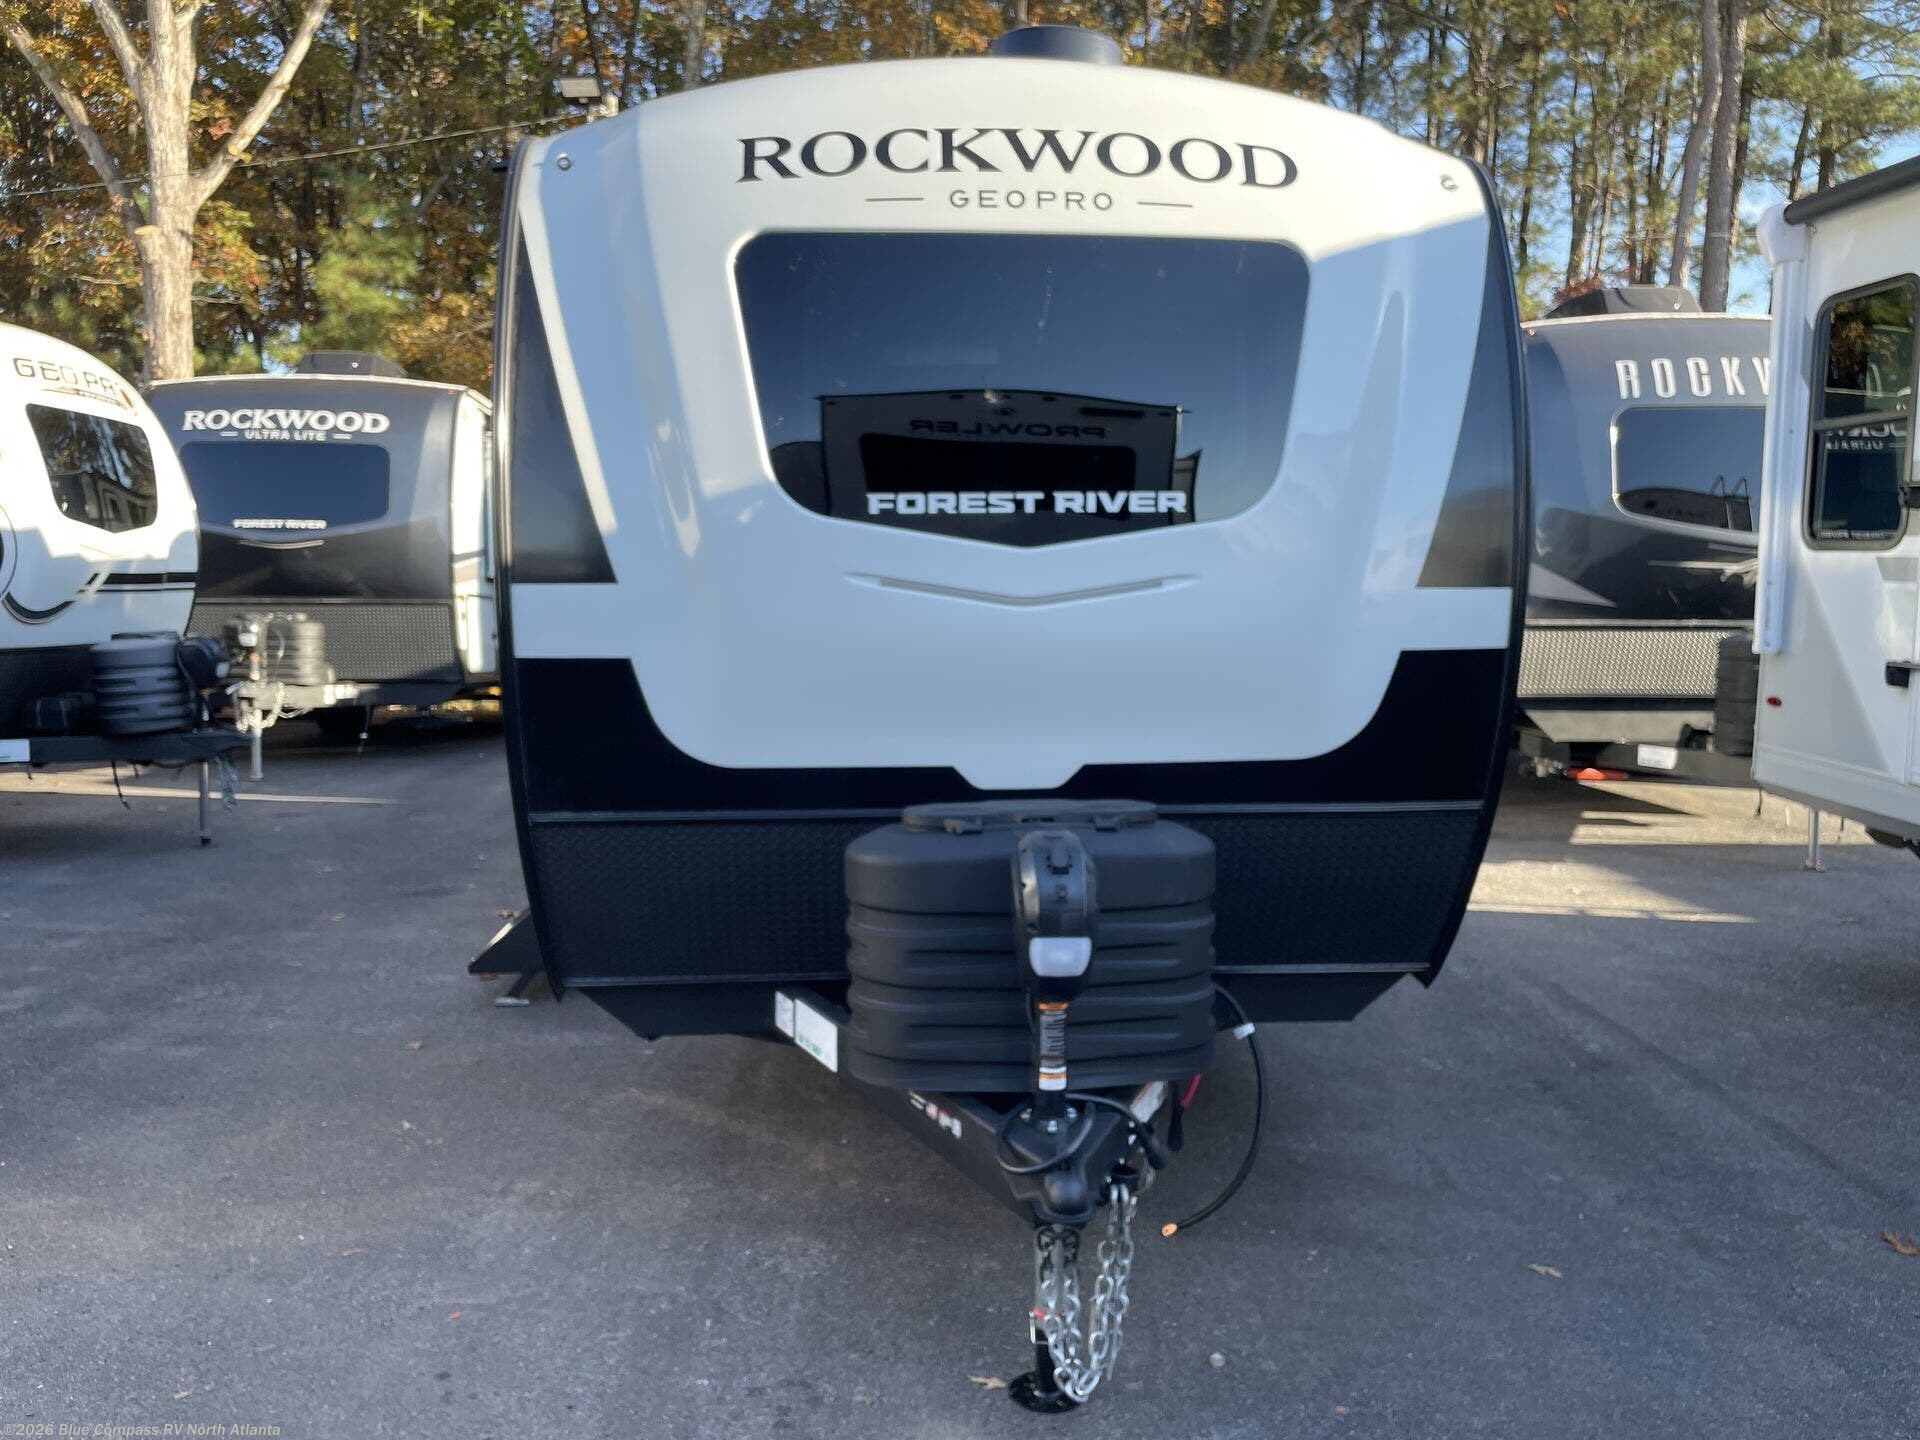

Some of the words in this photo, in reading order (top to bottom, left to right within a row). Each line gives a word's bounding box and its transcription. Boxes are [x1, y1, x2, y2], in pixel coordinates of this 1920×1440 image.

[736, 127, 1298, 189] ROCKWOOD
[949, 189, 1114, 211] GEOPRO
[182, 409, 390, 433] ROCKWOOD
[244, 429, 290, 440] ULTRA
[294, 430, 326, 441] LITE
[866, 490, 1045, 515] FOREST
[1052, 490, 1187, 513] RIVER
